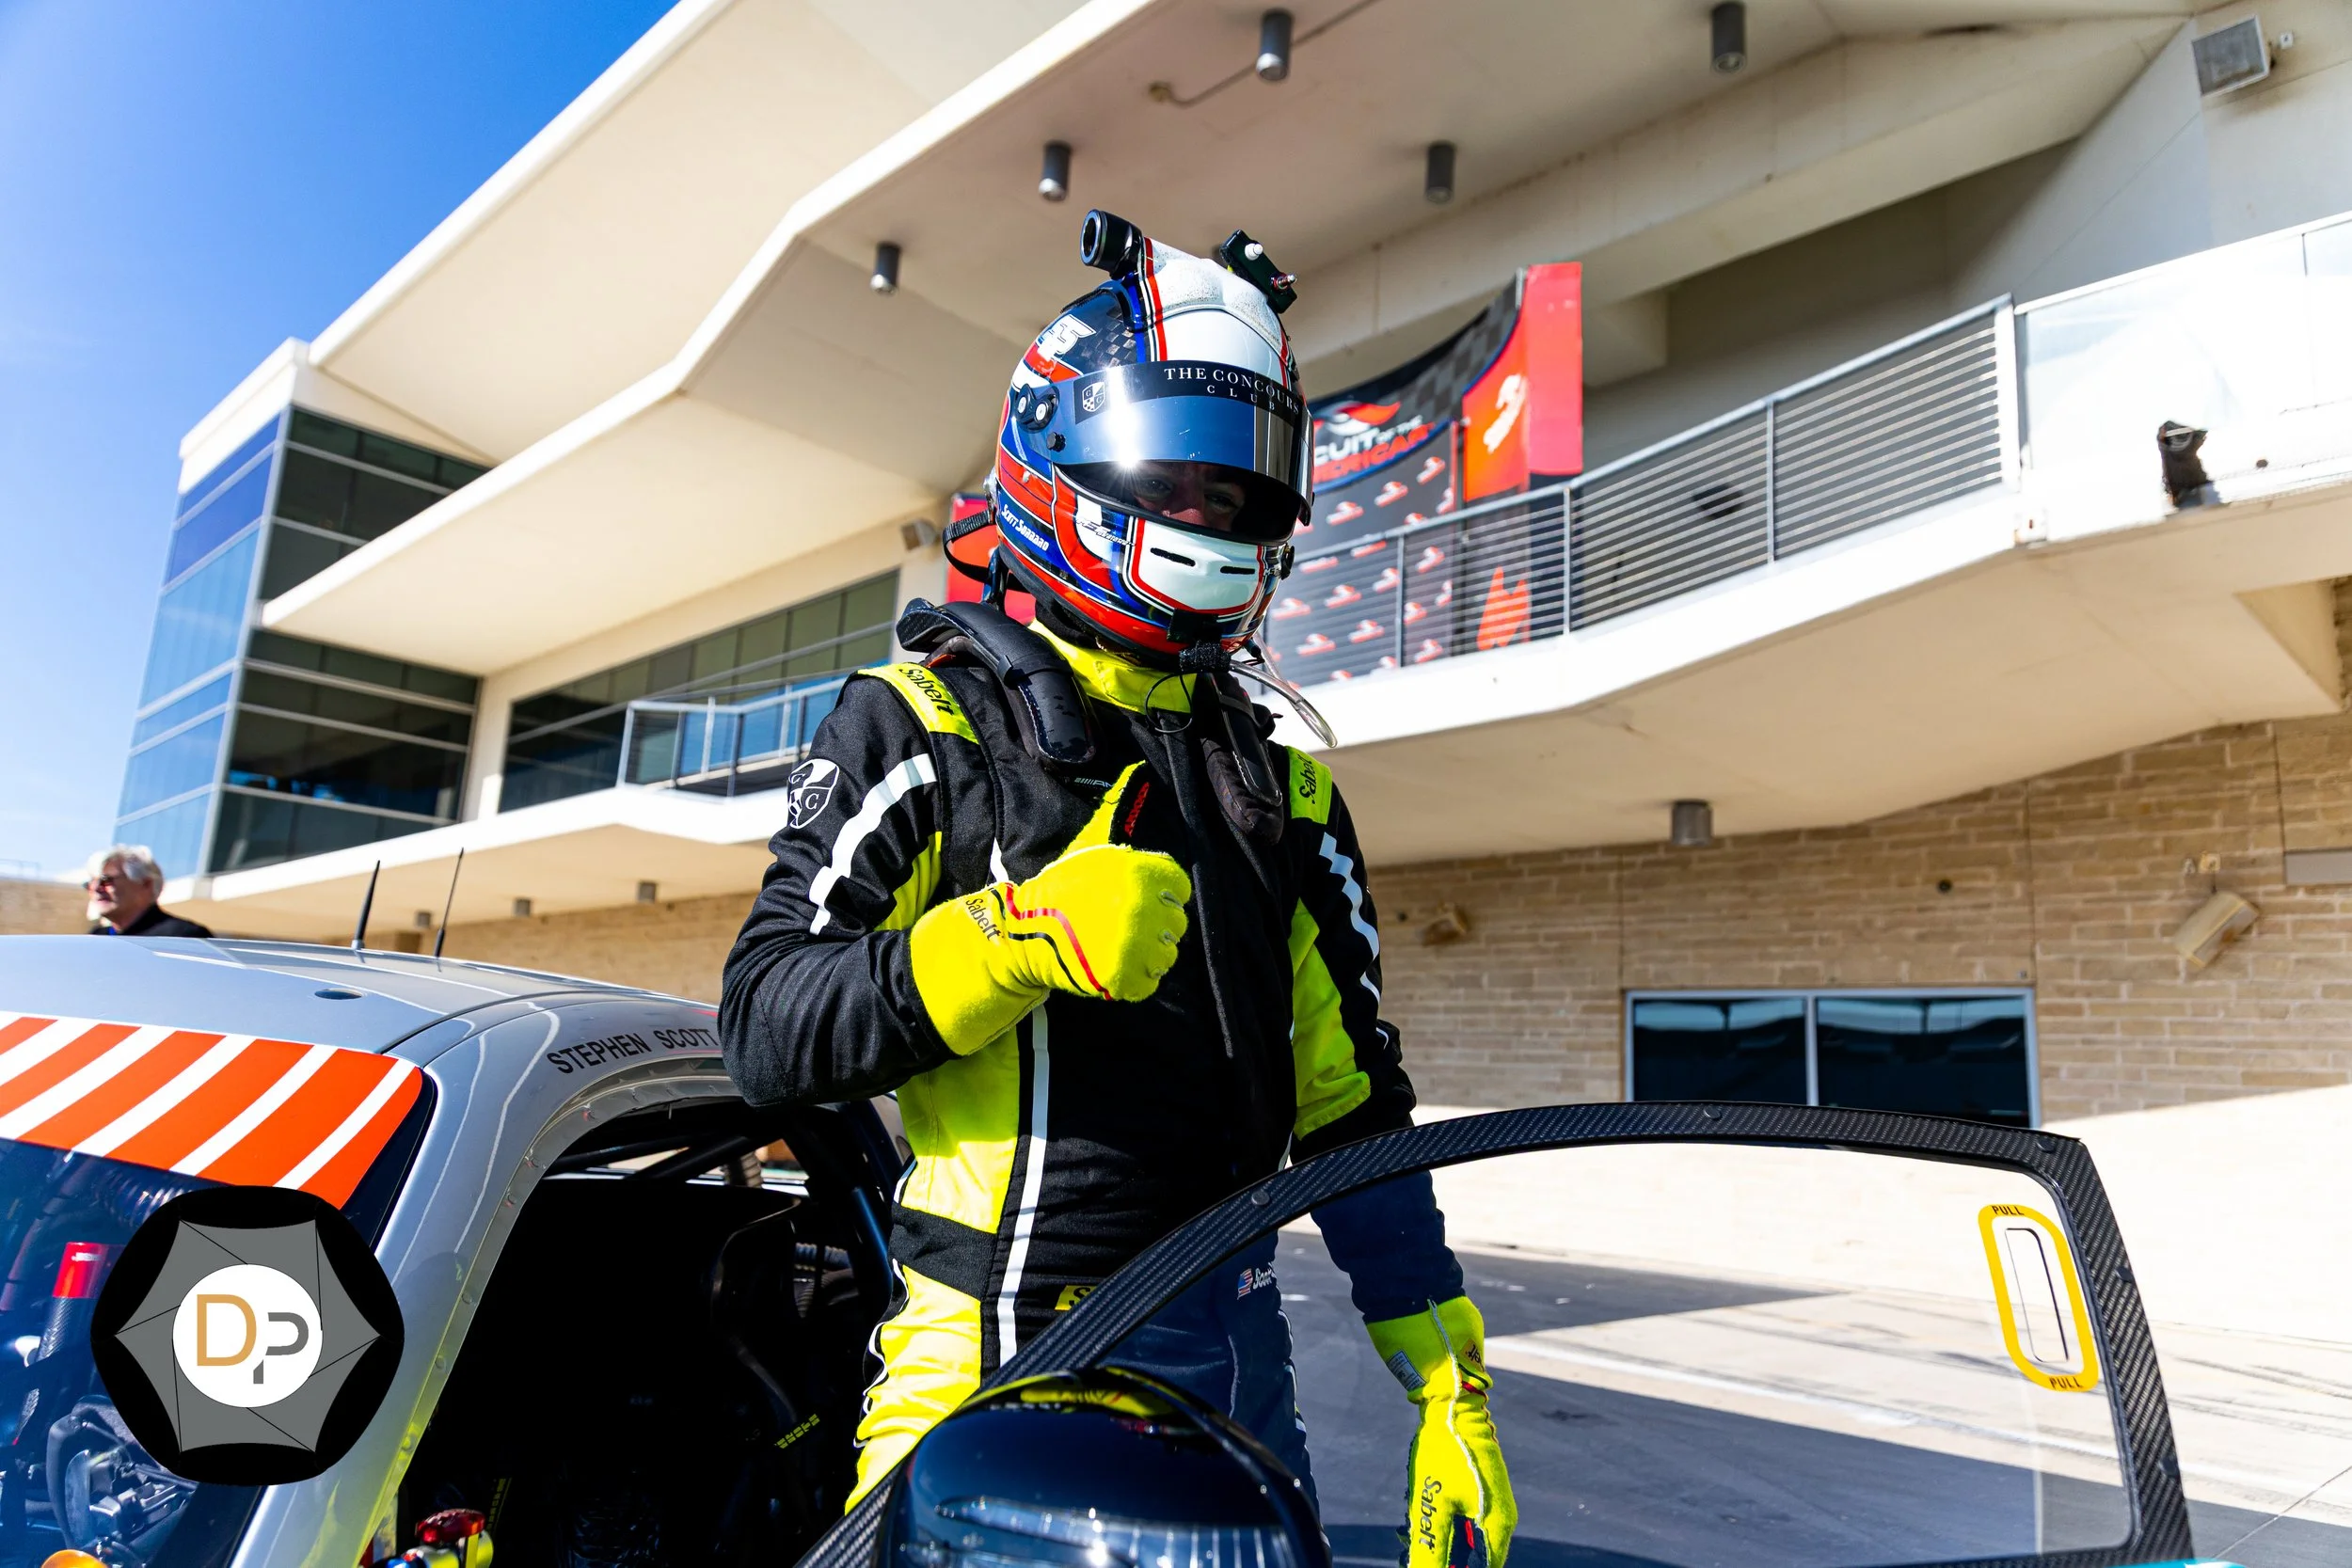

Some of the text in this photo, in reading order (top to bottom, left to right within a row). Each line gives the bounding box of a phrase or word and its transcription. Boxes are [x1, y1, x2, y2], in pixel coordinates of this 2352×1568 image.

[1164, 366, 1300, 415] THE CONCOURS
[898, 667, 955, 717] Sabelt
[965, 898, 1002, 941] Sabelt
[547, 1028, 720, 1074] STEPHEN SCOTT
[1992, 1205, 2025, 1215] PULL
[2049, 1376, 2084, 1389] PULL
[1419, 1476, 1442, 1550] Sabelt
